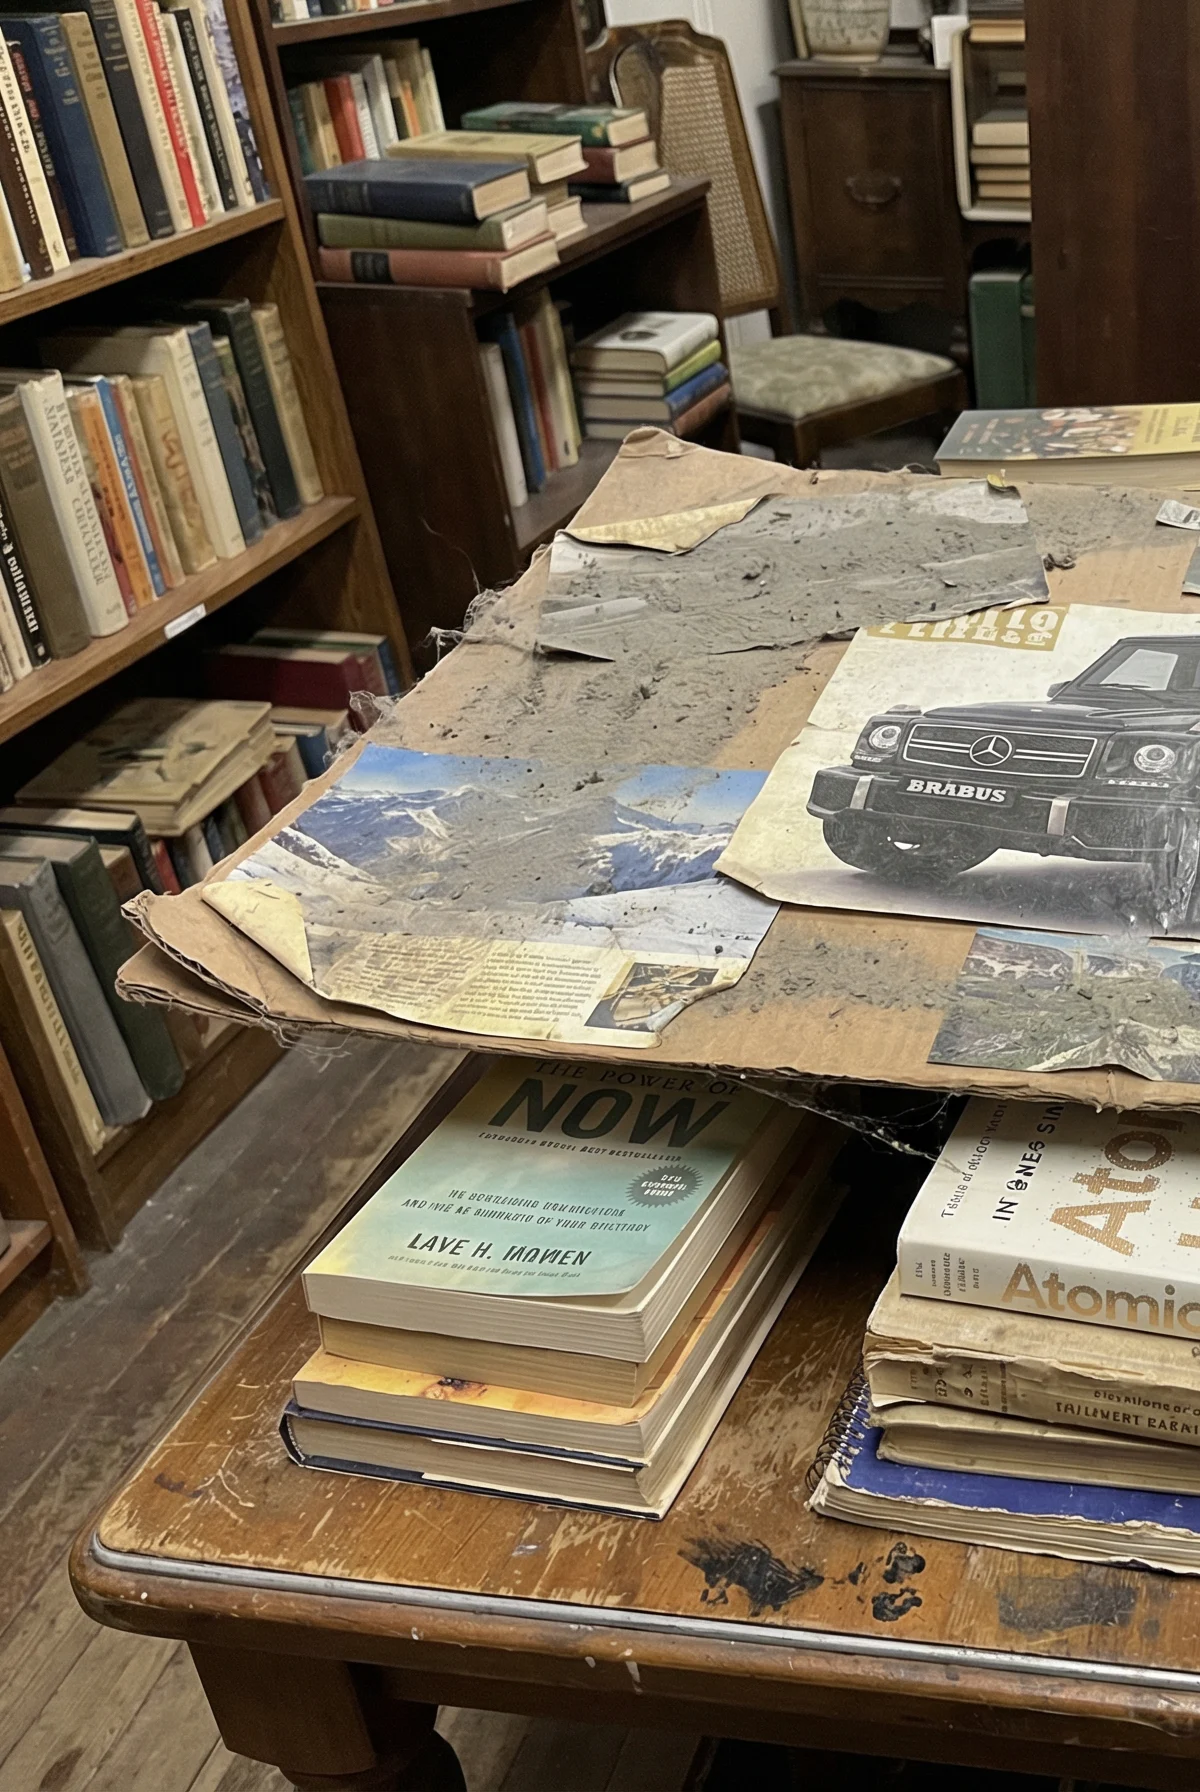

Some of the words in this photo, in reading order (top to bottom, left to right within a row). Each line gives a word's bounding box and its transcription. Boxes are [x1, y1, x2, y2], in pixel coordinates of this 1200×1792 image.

[906, 779, 1007, 803] BRABUS
[534, 1060, 587, 1080] THE
[600, 1069, 696, 1093] POWER
[708, 1080, 743, 1096] OF
[488, 1078, 732, 1149] NOW
[401, 1198, 427, 1210] AND
[992, 1196, 1019, 1222] IN
[406, 1232, 471, 1256] LAVE
[471, 1241, 493, 1260] H.
